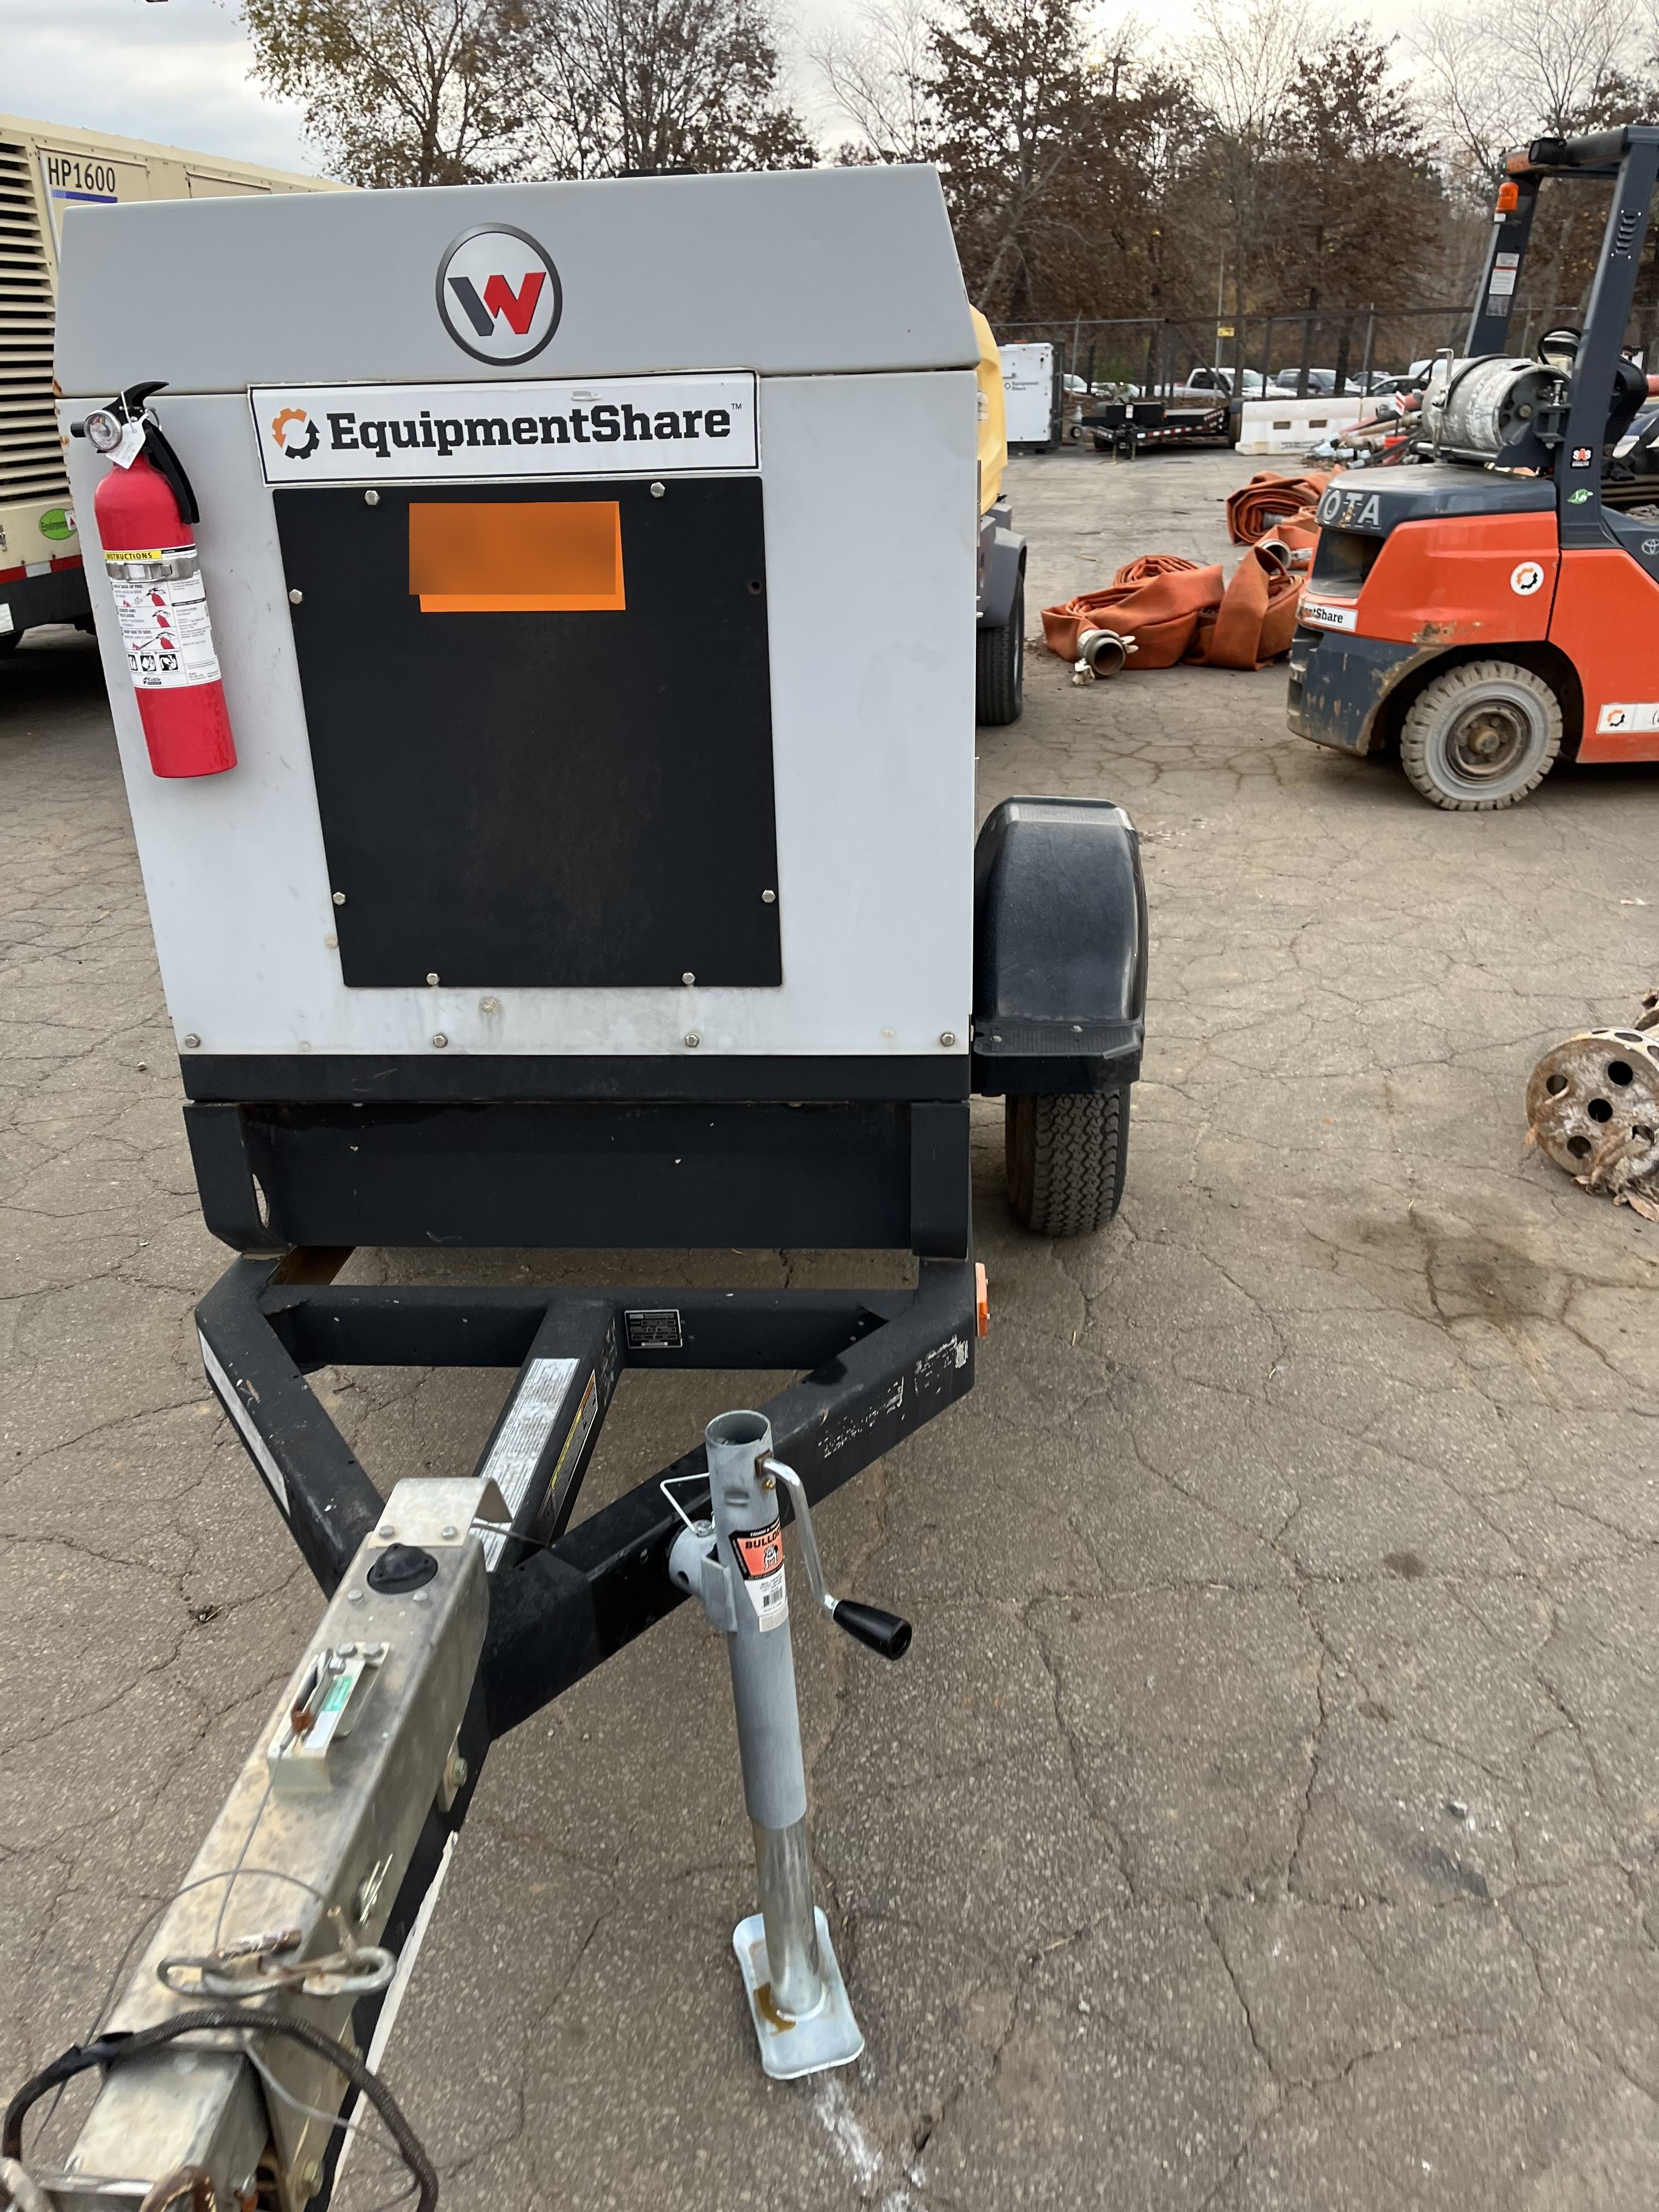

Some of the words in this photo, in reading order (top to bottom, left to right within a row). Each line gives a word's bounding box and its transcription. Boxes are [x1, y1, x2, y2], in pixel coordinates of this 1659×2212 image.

[47, 157, 116, 193] HP1600
[447, 272, 547, 337] W
[326, 404, 731, 458] EquipmentShare
[1322, 489, 1380, 526] OTA
[745, 1527, 781, 1549] BULLDO
